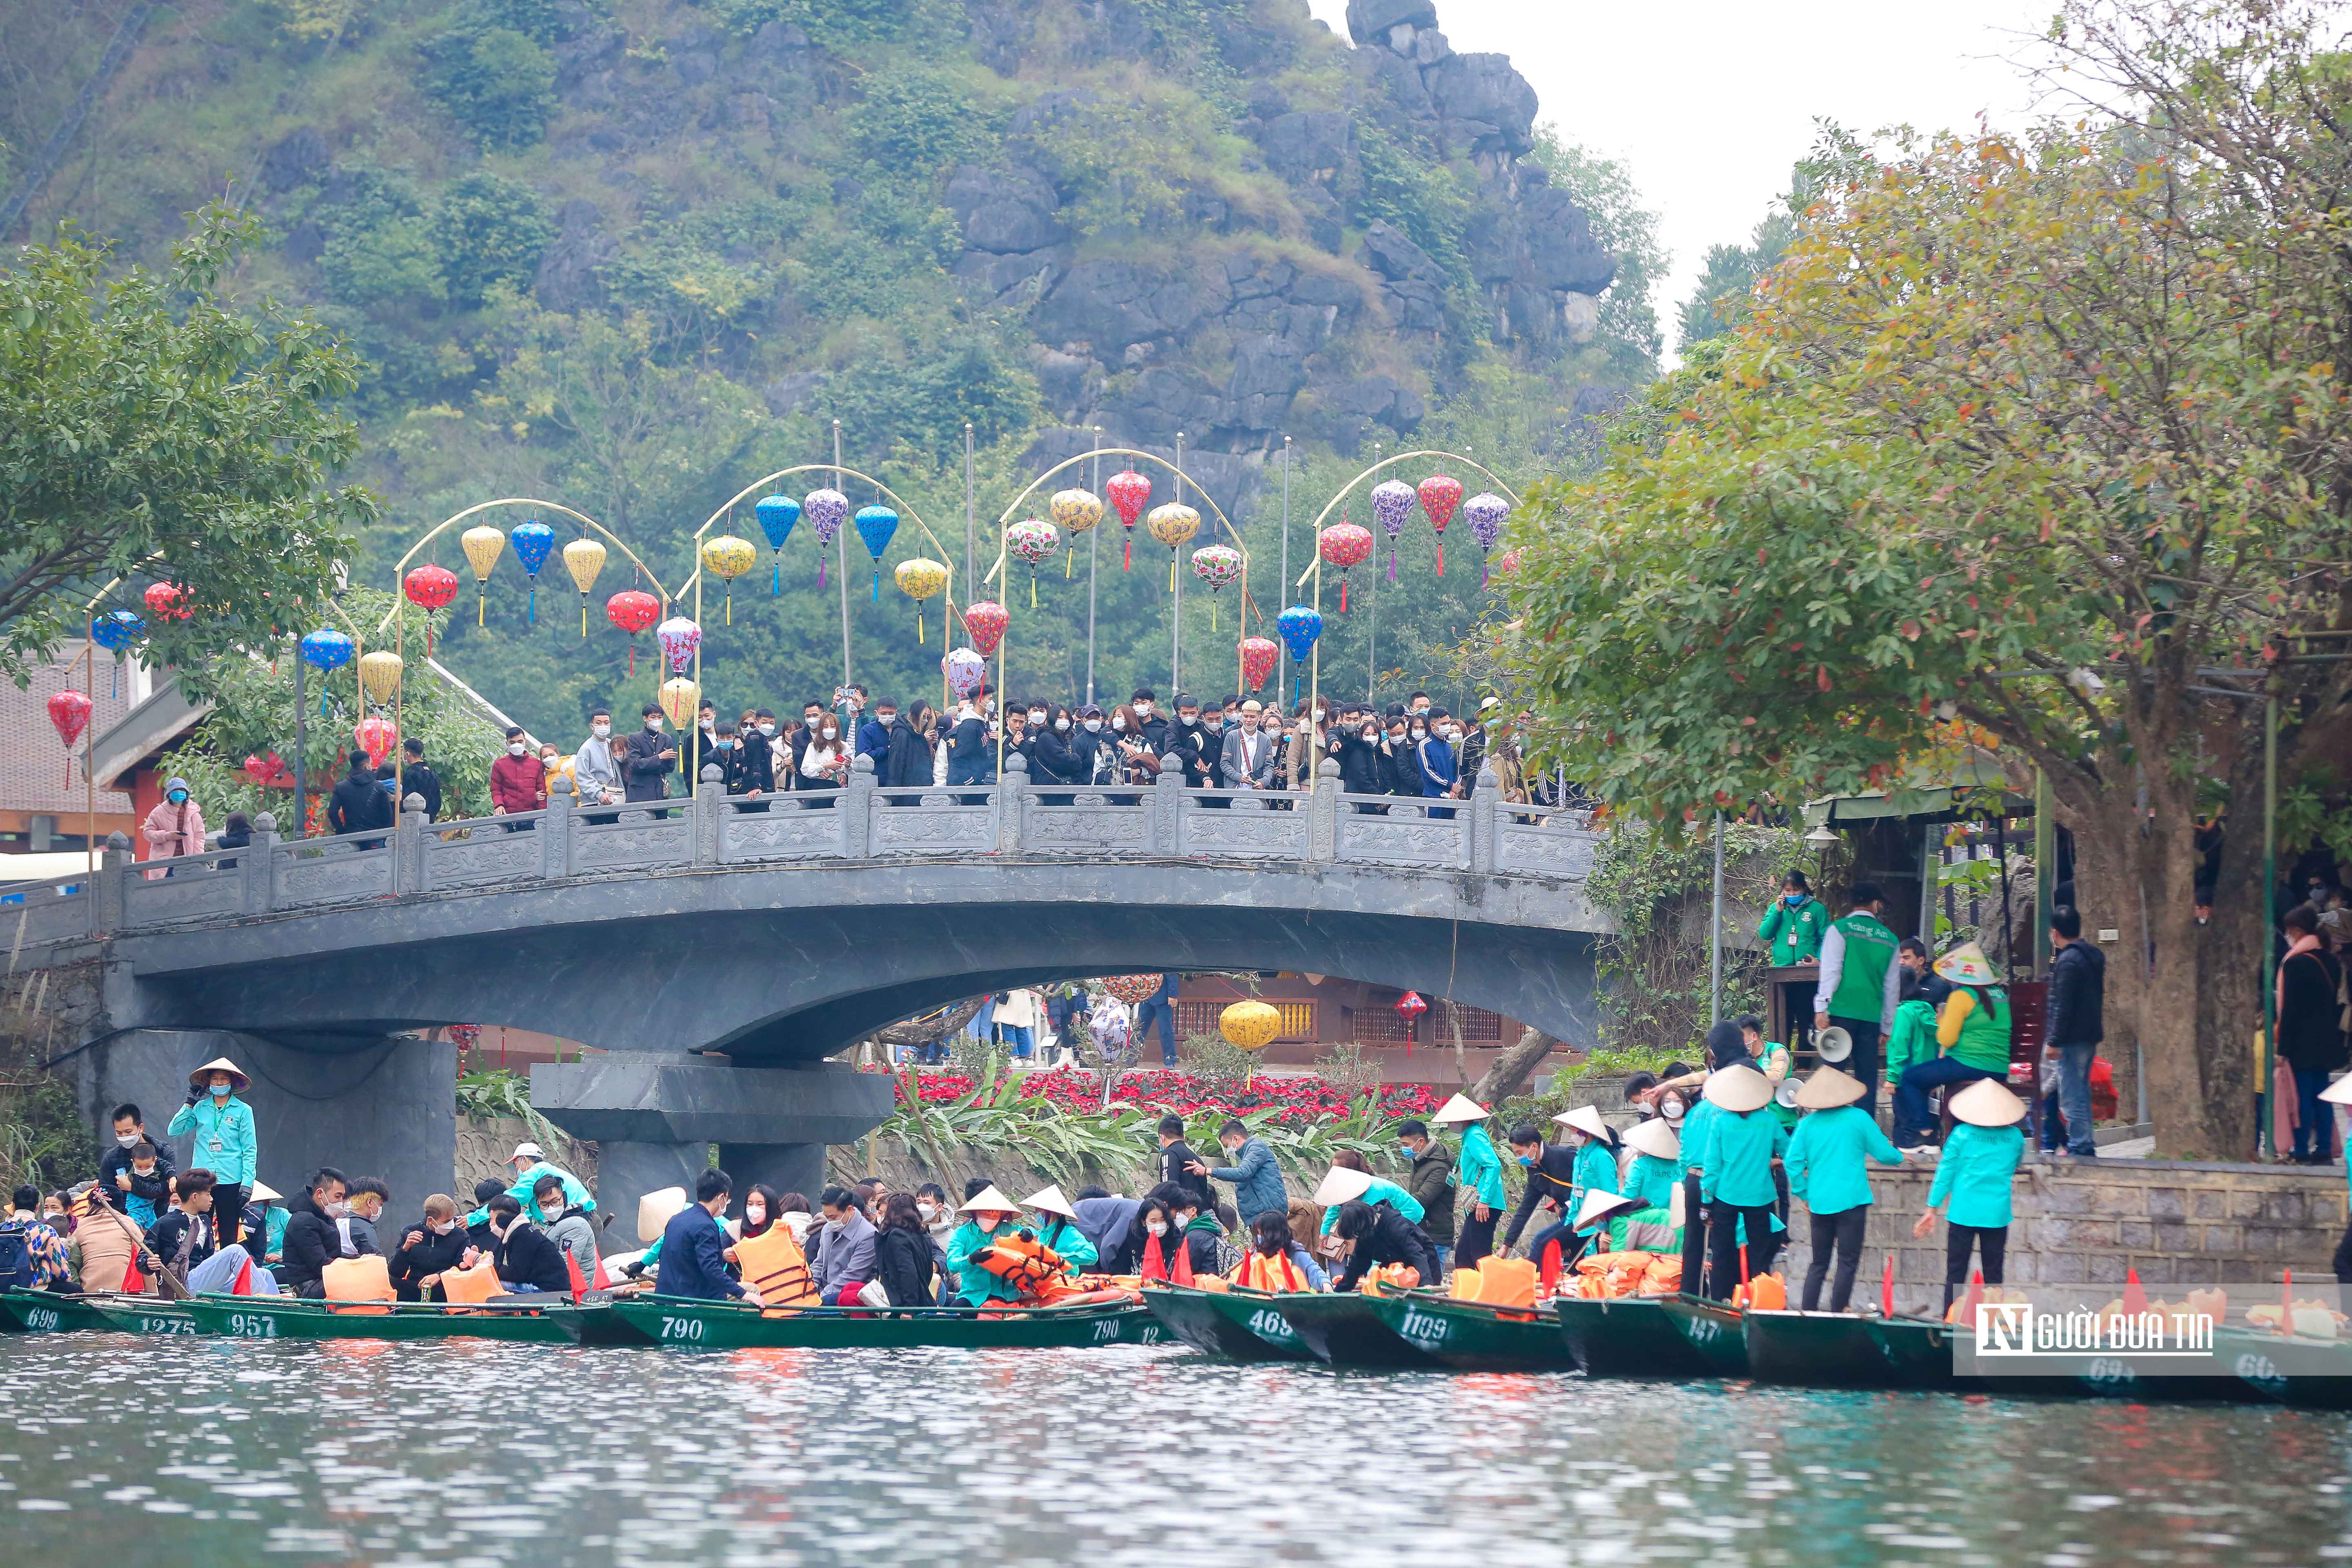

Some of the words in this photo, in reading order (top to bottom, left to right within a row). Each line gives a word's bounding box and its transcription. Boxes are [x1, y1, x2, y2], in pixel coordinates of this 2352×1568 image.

[28, 1306, 58, 1329] 699
[141, 1317, 196, 1334] 1275
[231, 1314, 276, 1338] 957
[661, 1316, 703, 1340] 790
[1401, 1312, 1447, 1339] 1109
[1093, 1319, 1119, 1341] 790
